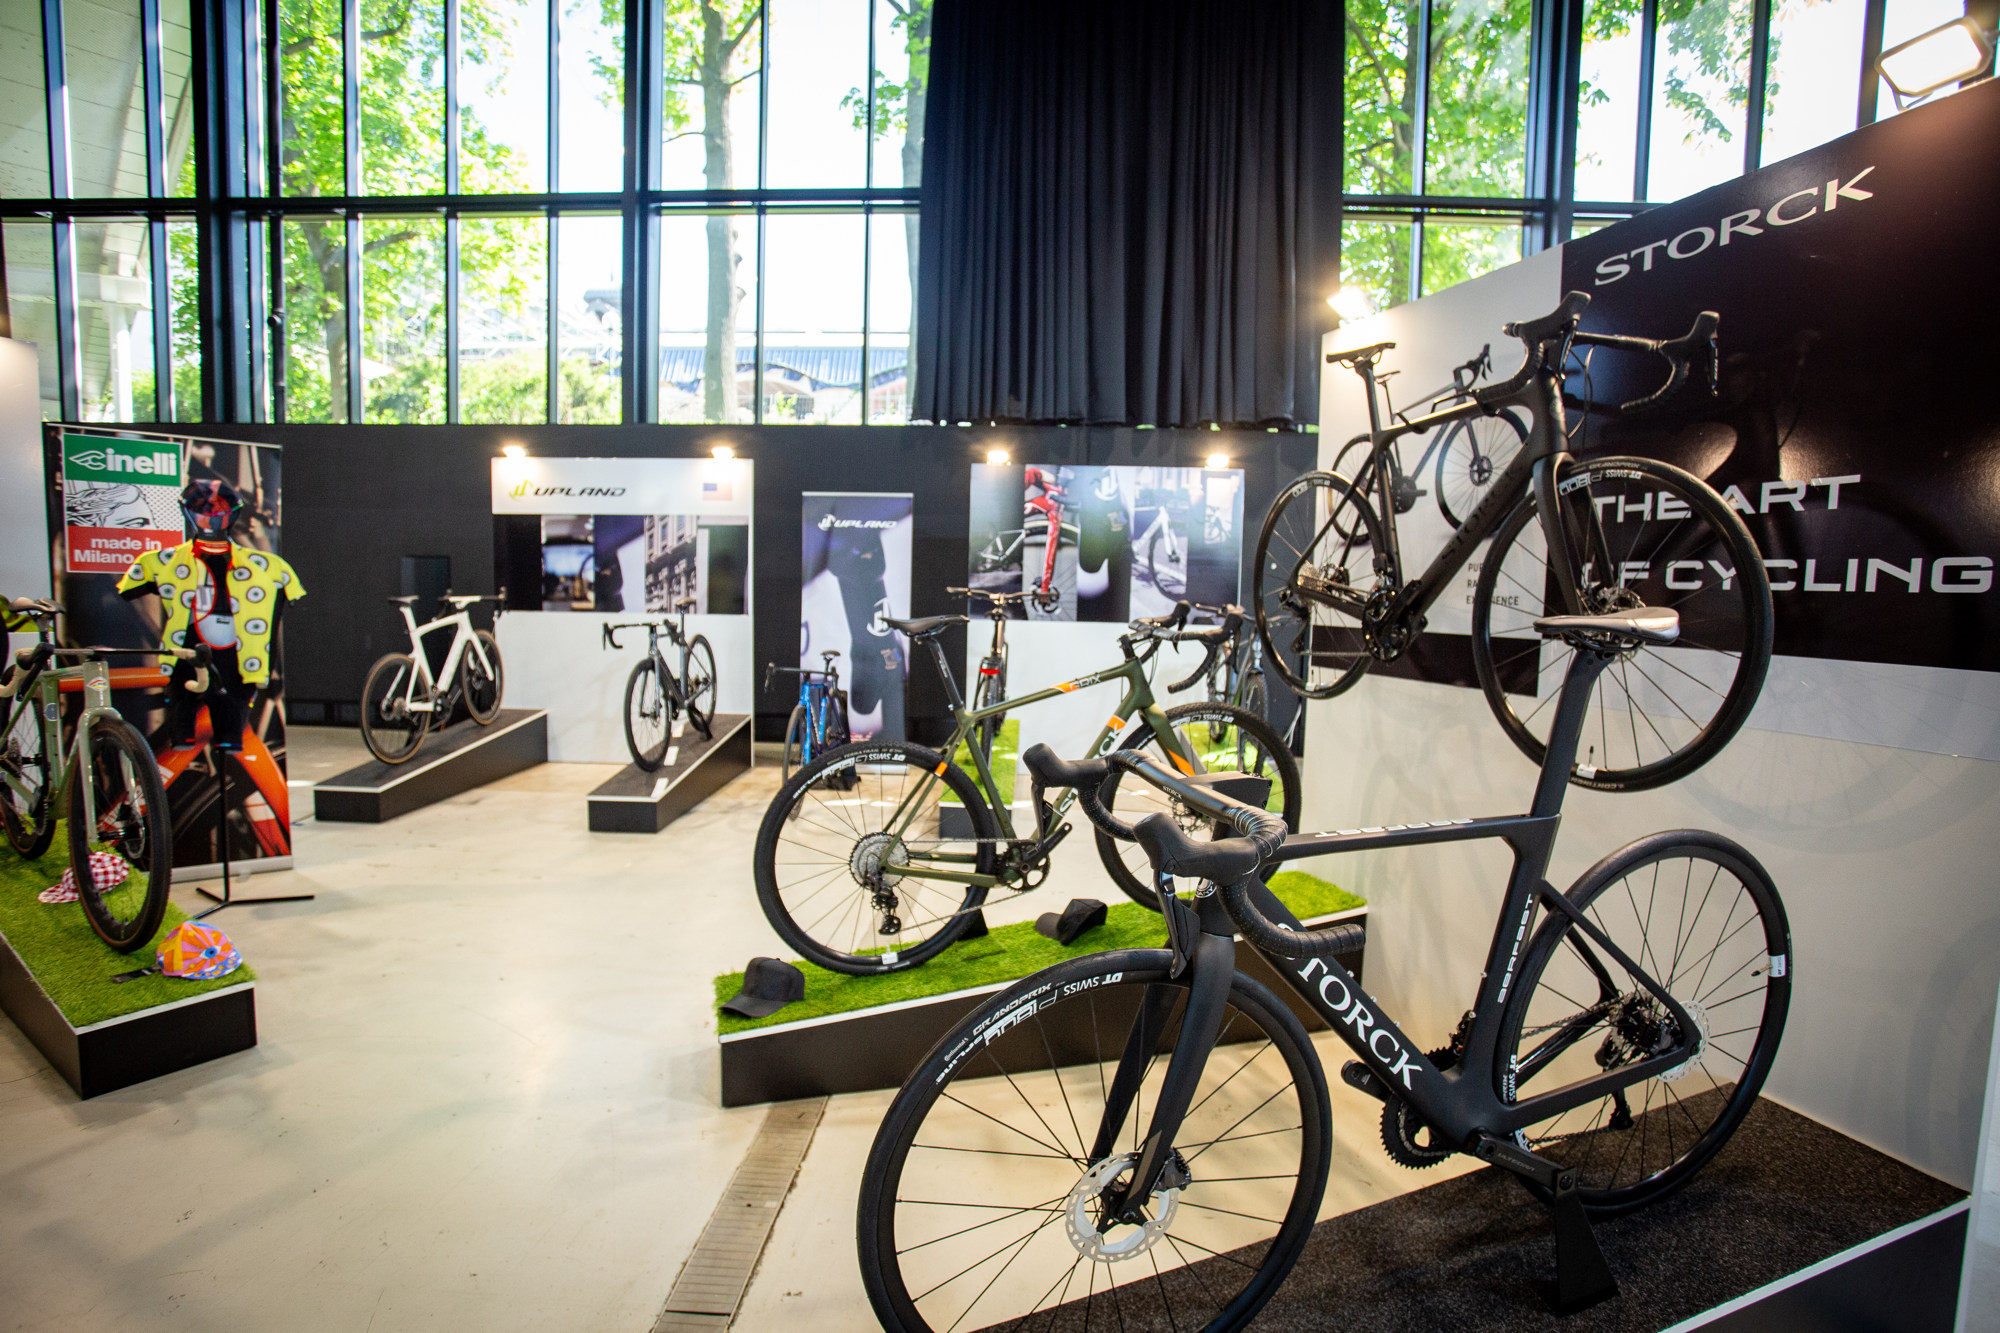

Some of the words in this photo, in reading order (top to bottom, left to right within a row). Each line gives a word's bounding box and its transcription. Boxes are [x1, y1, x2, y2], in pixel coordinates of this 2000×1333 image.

[1595, 165, 1876, 286] STORCK
[1605, 469, 1628, 478] SWISS
[534, 486, 626, 497] UPLAND
[1593, 490, 1693, 523] THE
[1721, 474, 1861, 515] ART
[834, 519, 897, 529] UPLAND
[91, 537, 142, 550] made
[146, 537, 162, 550] in
[74, 549, 135, 565] Milano
[1664, 556, 1995, 594] CYCLING
[1162, 785, 1183, 800] STORCK
[1063, 976, 1101, 997] SWISS
[1102, 972, 1124, 985] DT
[972, 982, 1053, 1037] GRANDPRIX
[1277, 922, 1423, 1091] TORCK
[1508, 1072, 1516, 1102] SWISS
